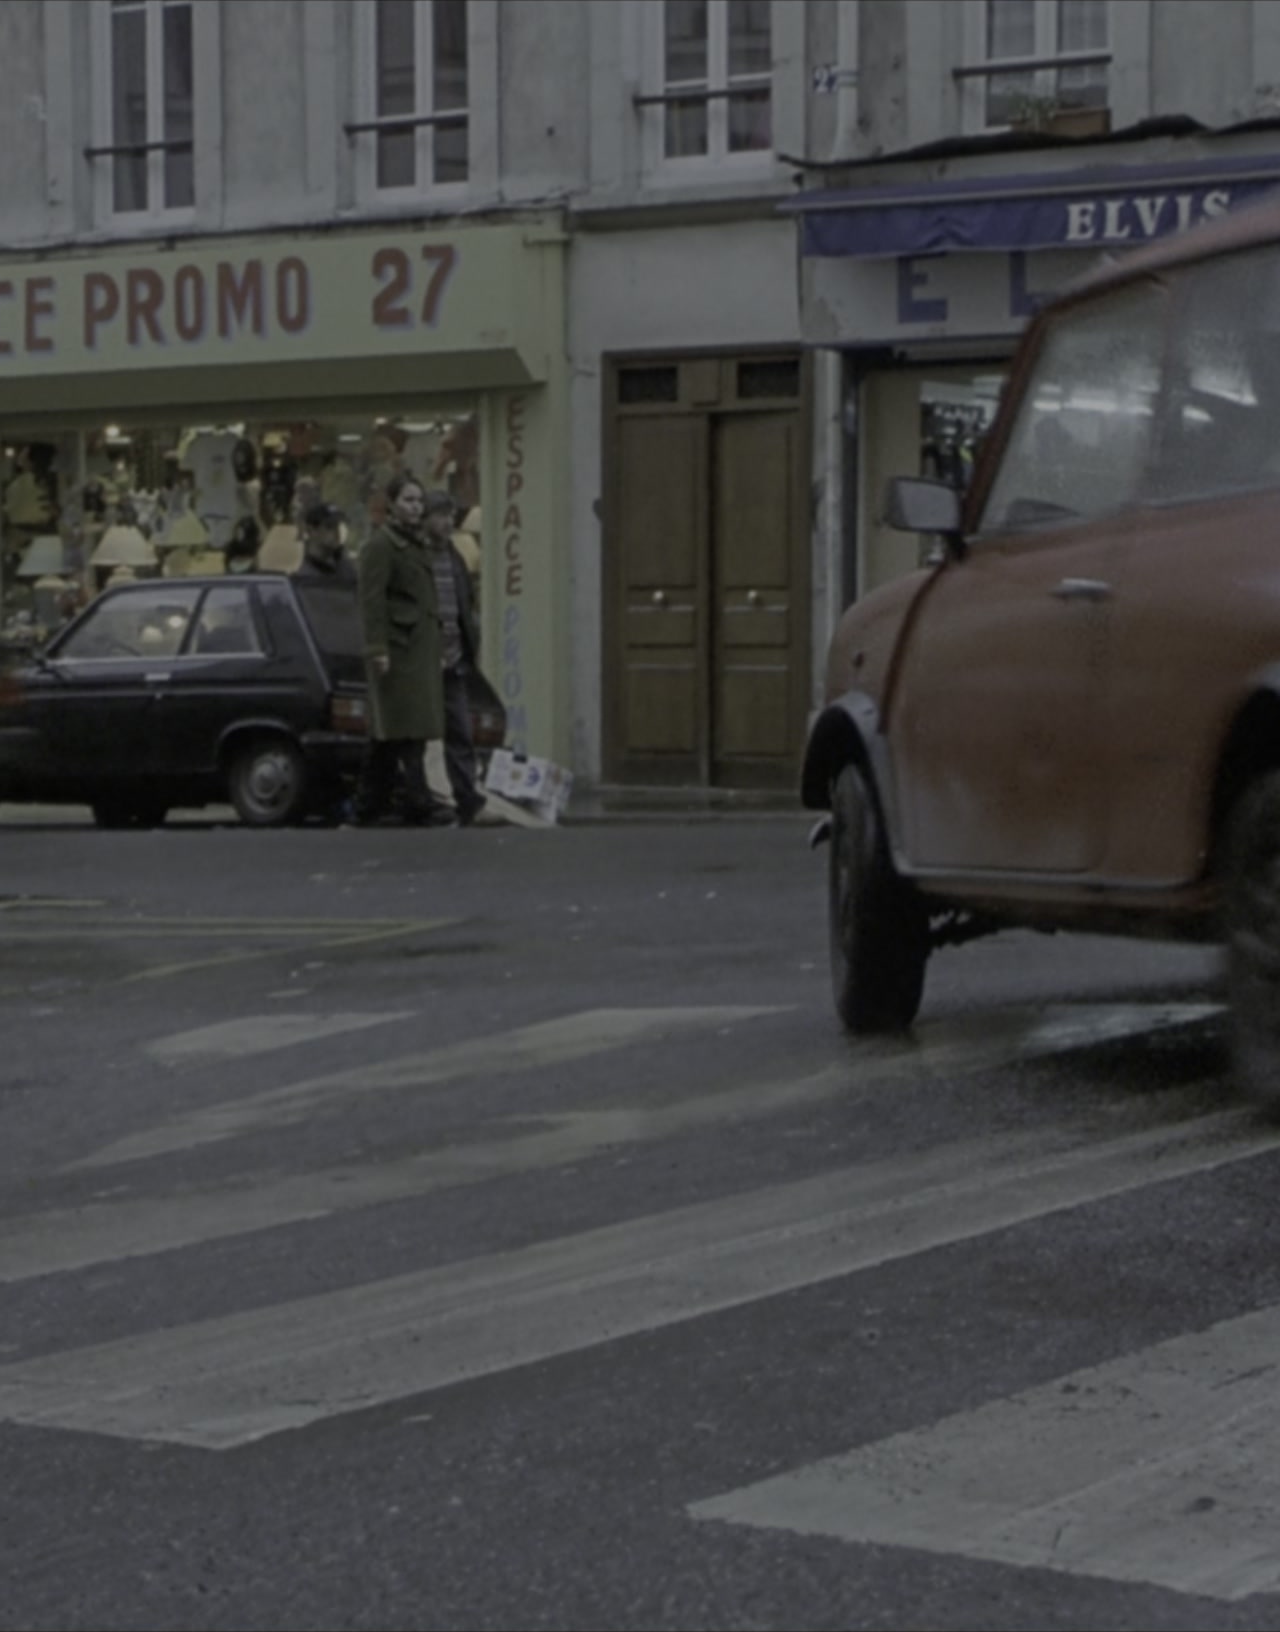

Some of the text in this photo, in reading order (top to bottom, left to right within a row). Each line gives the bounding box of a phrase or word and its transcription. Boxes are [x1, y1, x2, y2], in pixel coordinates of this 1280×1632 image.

[1066, 191, 1231, 241] ELVIS
[83, 256, 310, 349] PROMO
[371, 245, 457, 328] 27
[503, 395, 525, 597] ESPACE
